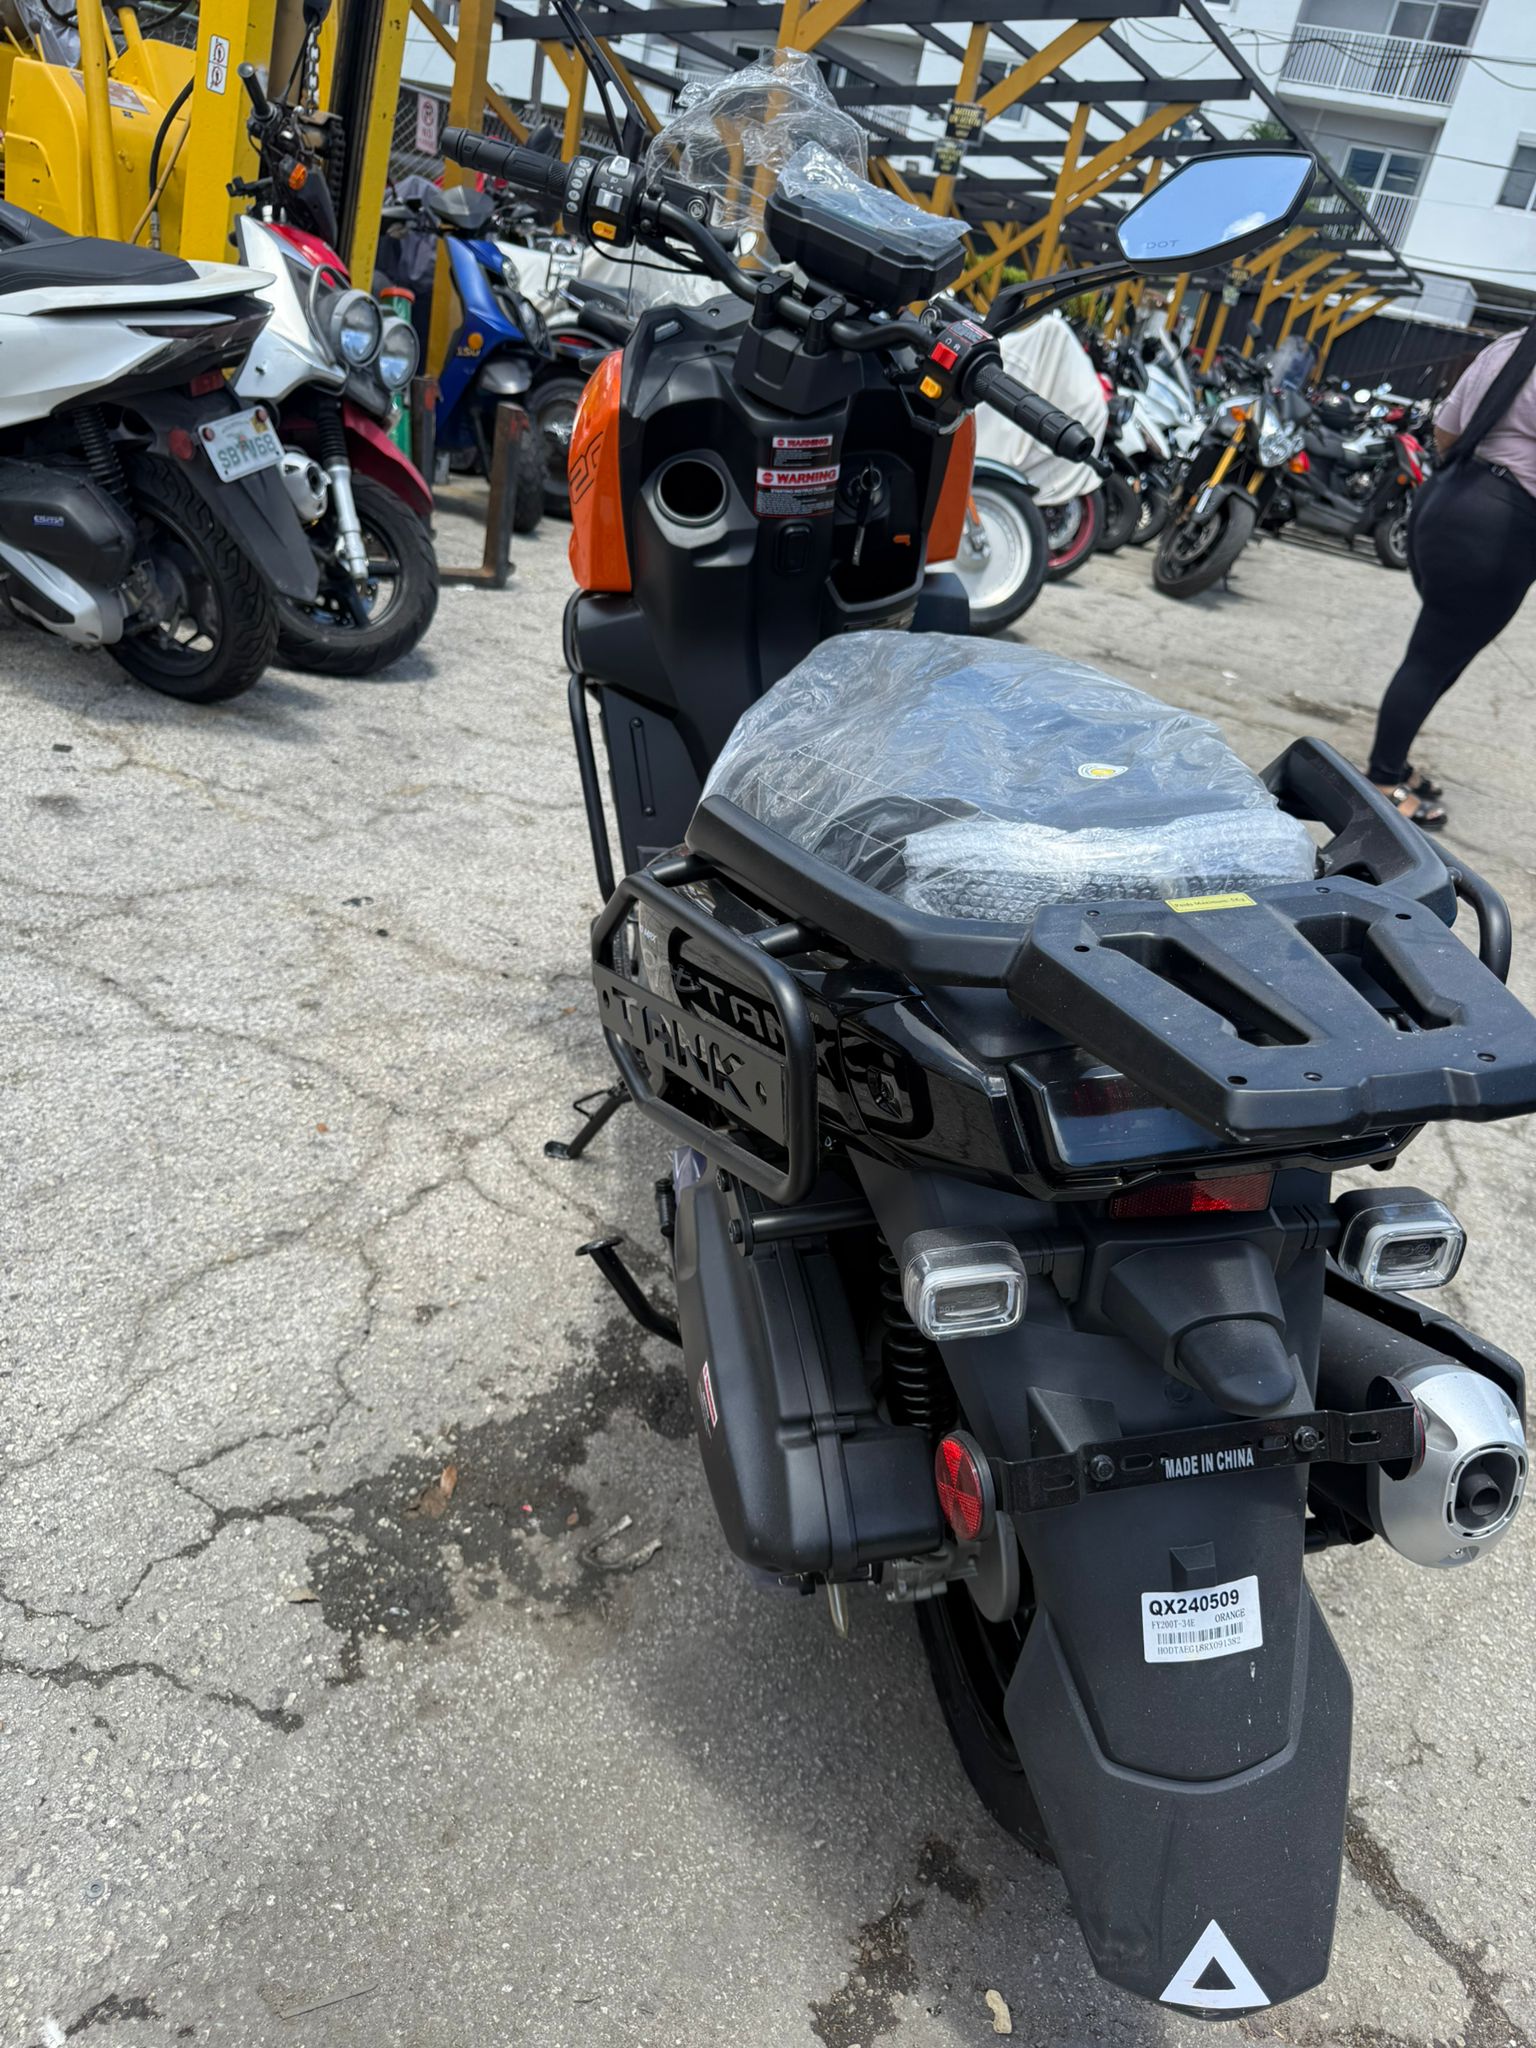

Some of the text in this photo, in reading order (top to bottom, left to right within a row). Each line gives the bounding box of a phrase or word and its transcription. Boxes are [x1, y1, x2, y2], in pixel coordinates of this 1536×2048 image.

[1145, 239, 1180, 249] DOT
[787, 437, 829, 448] WARNING
[776, 469, 837, 485] WARNING
[611, 986, 752, 1112] TANK
[1165, 1447, 1255, 1479] MADE IN CHINA
[1149, 1589, 1240, 1616] QX240509
[1214, 1608, 1246, 1623] ORANGE
